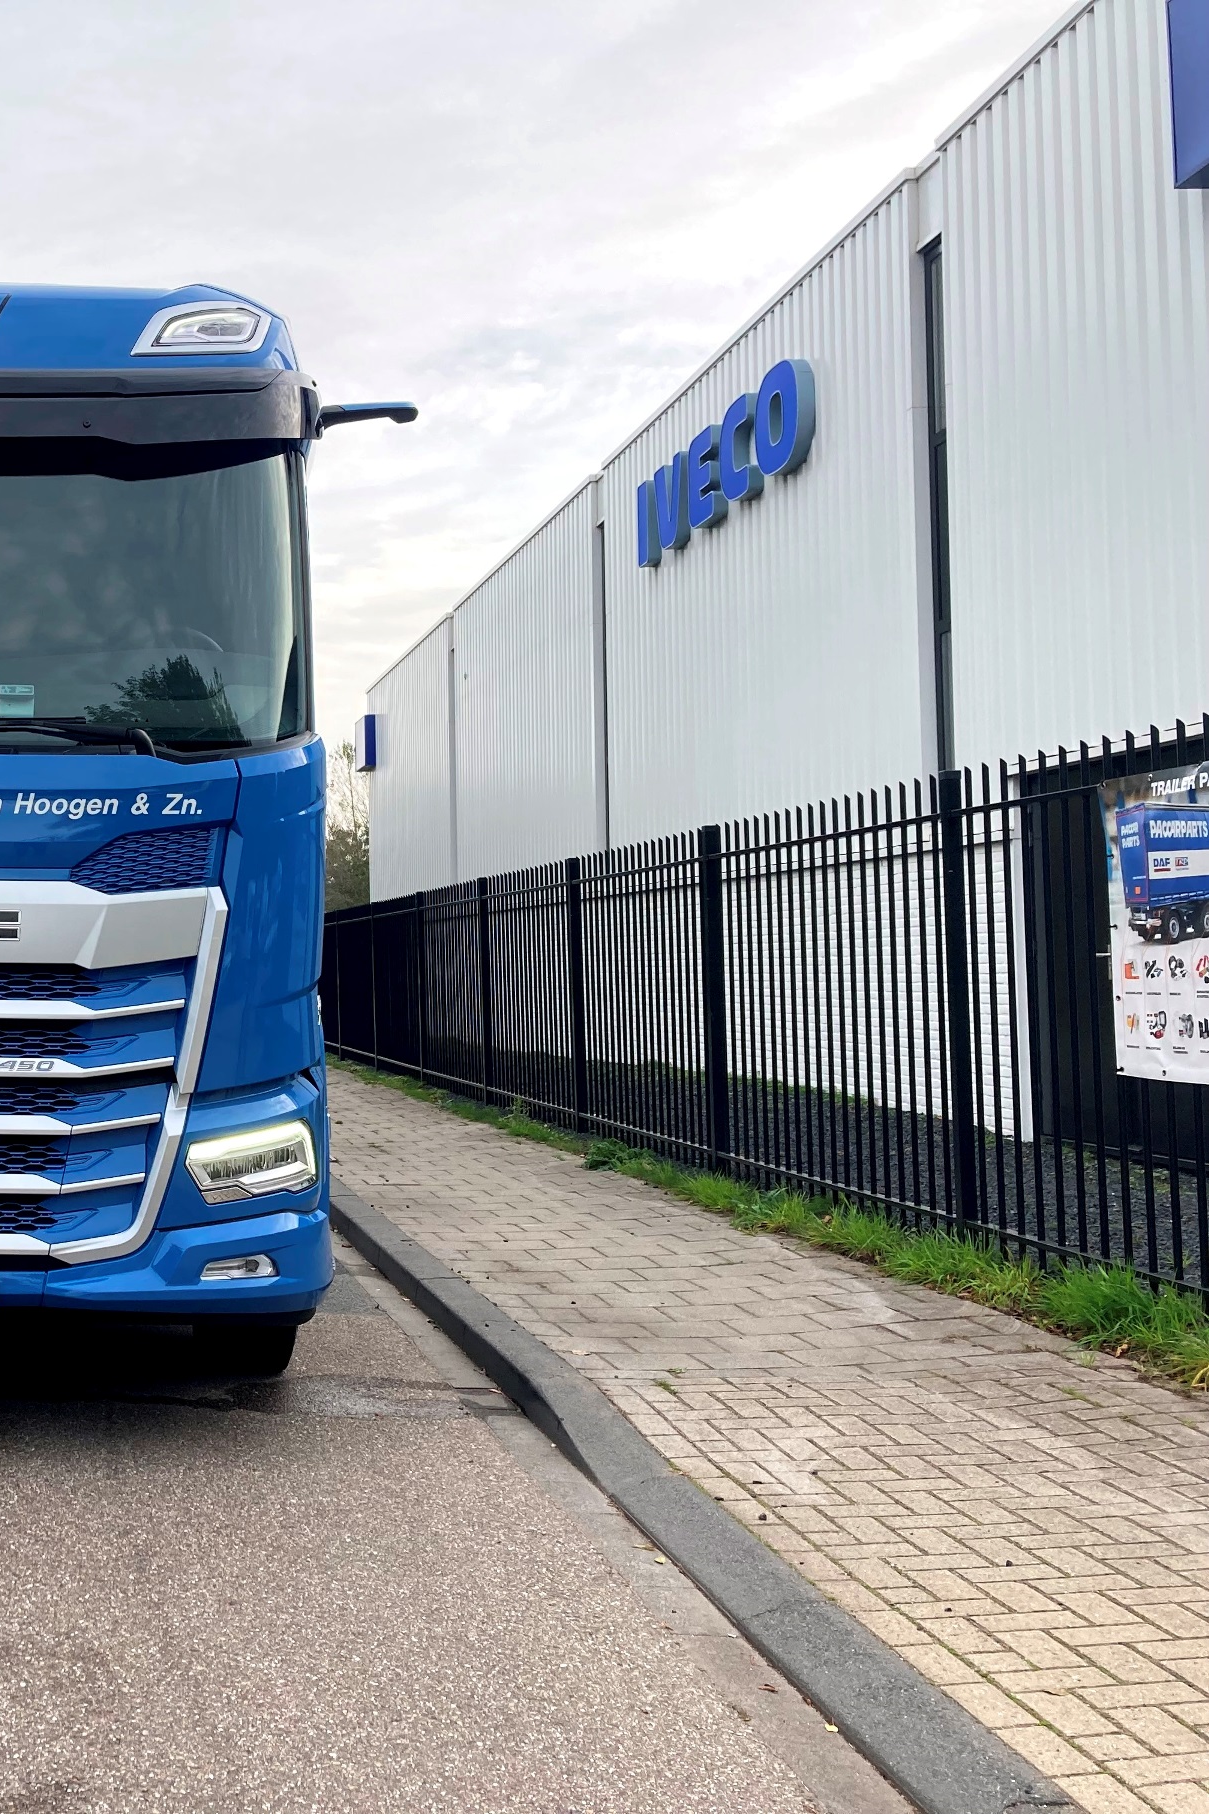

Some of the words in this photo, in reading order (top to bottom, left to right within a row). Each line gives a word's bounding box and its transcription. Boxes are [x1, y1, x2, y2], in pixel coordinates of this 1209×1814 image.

[637, 359, 816, 568] IVECO
[1151, 775, 1196, 796] TRAILER
[1199, 772, 1209, 788] P
[13, 792, 118, 820] Hoogen
[130, 793, 150, 815] &
[161, 793, 203, 815] Zn.
[1122, 835, 1140, 849] PARTS
[1153, 858, 1170, 867] DAF
[0, 1060, 55, 1071] 450
